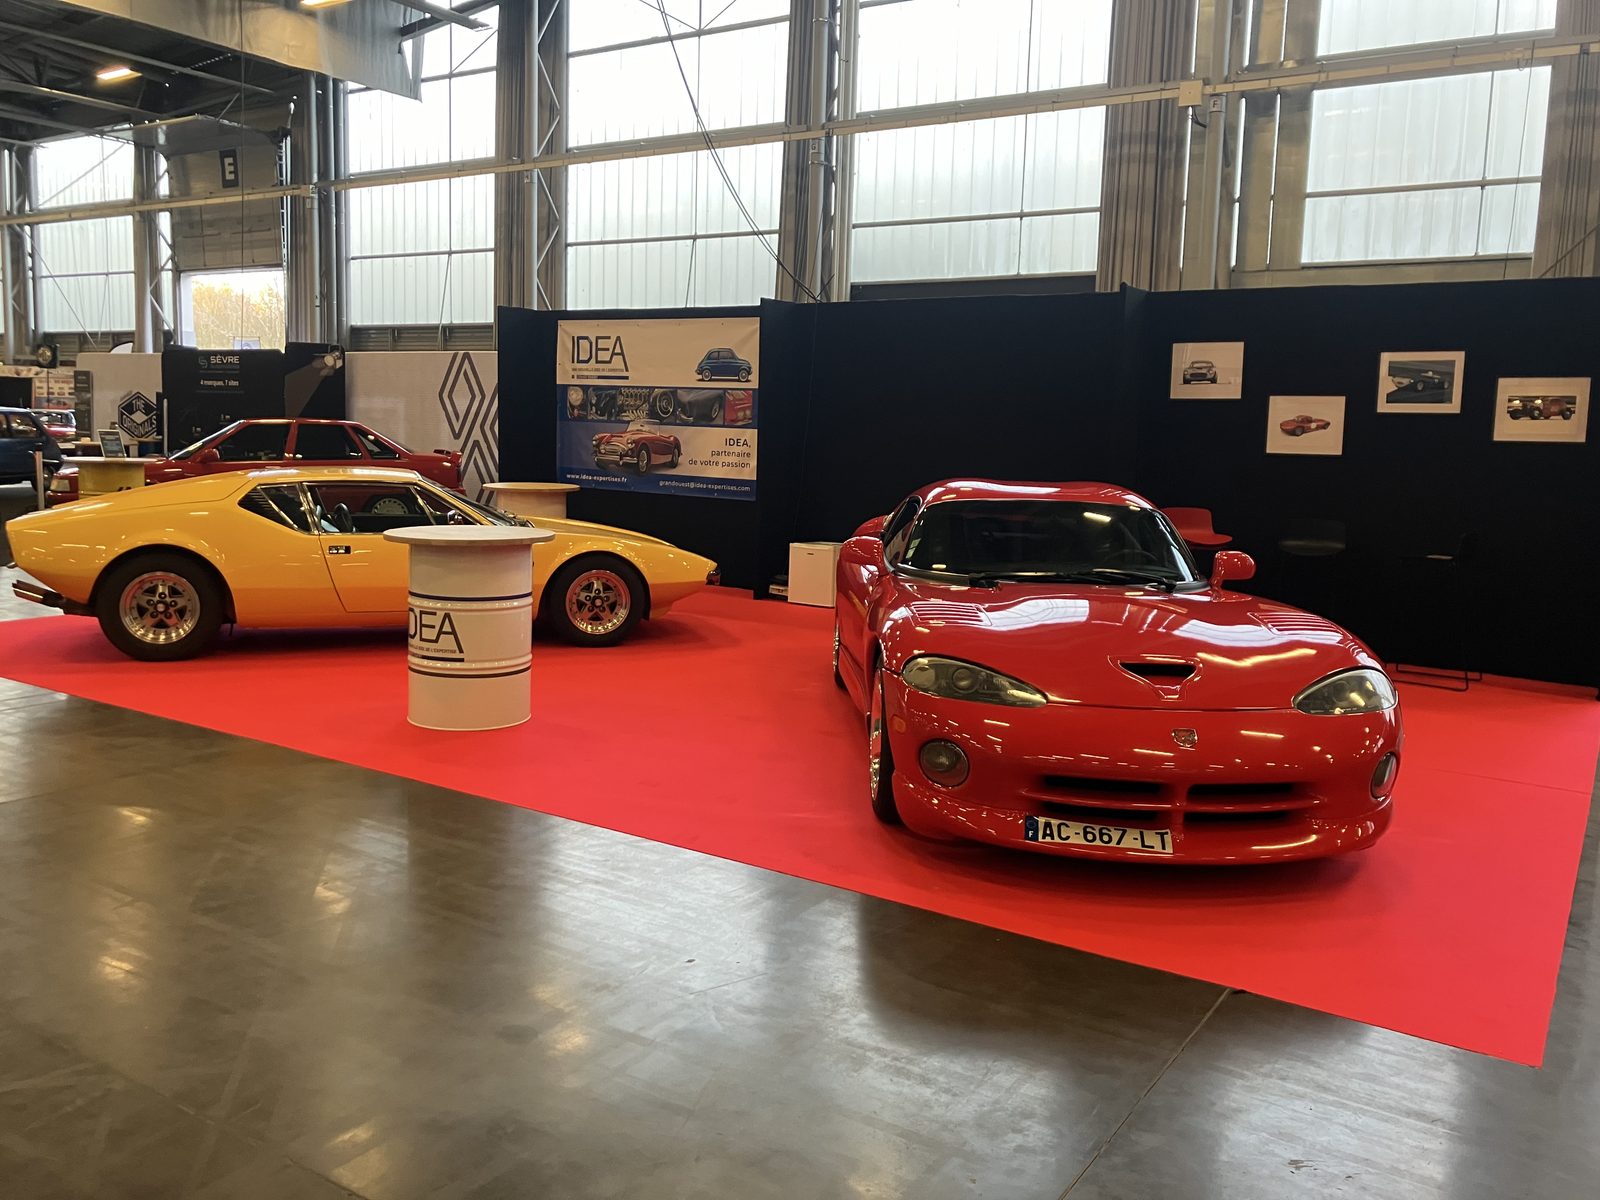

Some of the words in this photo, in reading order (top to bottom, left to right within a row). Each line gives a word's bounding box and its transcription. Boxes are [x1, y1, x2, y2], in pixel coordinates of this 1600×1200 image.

[223, 157, 235, 180] E
[571, 335, 630, 372] IDEA
[132, 397, 146, 414] THE
[122, 414, 158, 436] ORIGINALS
[724, 438, 752, 449] IDEA,
[710, 449, 752, 459] partenaire
[688, 458, 699, 466] de
[700, 459, 720, 467] votre
[721, 461, 751, 470] passion
[659, 480, 751, 492] grandouest@idea-expertises.com
[408, 607, 465, 654] DEA
[1041, 819, 1169, 851] AC-667-LT
